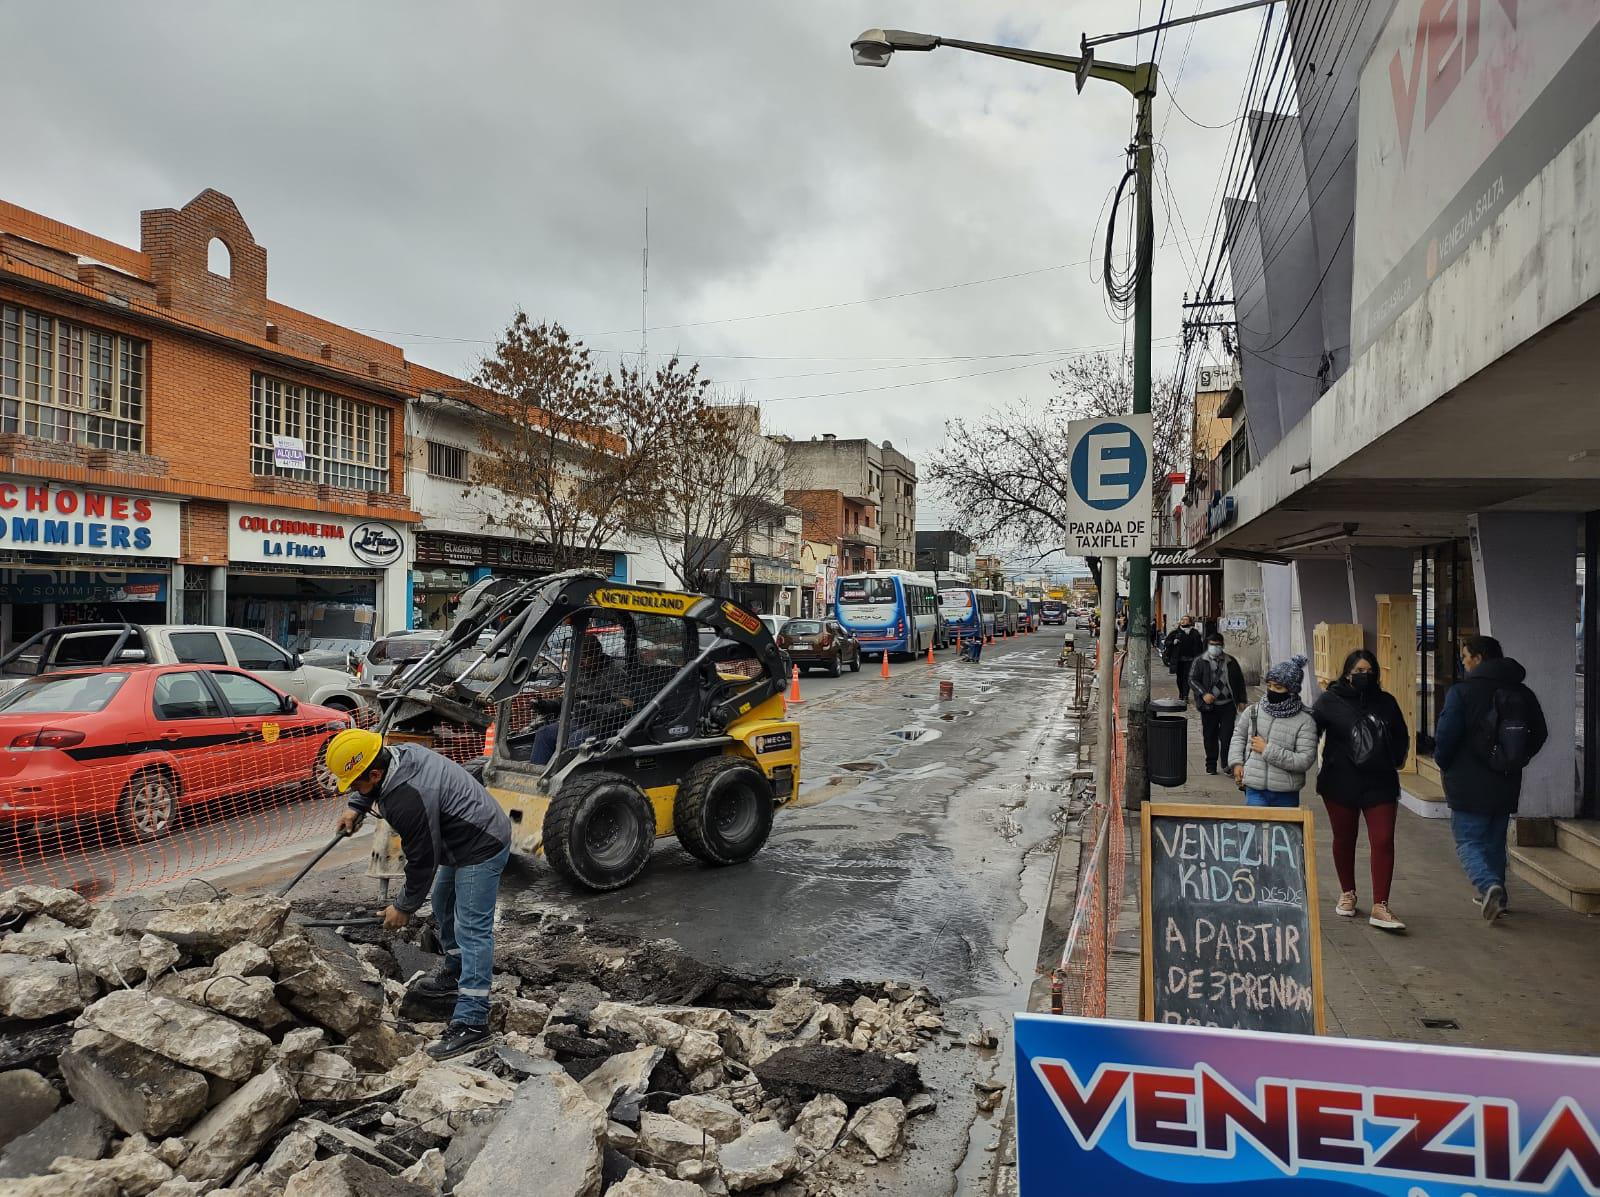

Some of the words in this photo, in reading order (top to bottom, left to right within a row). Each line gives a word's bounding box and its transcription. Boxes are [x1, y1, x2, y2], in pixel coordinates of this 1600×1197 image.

[277, 448, 303, 460] ALQUILA
[1088, 432, 1131, 501] E
[239, 515, 345, 539] COLCHONERIA
[1069, 520, 1122, 534] PARADA
[1127, 520, 1146, 534] DE
[1075, 535, 1138, 549] TAXIFLET
[601, 591, 629, 605] NEW
[631, 595, 684, 610] HOLLAND
[1165, 917, 1187, 952] A
[1195, 918, 1301, 965] PARTIR
[1033, 1060, 1600, 1193] VENEZIA
